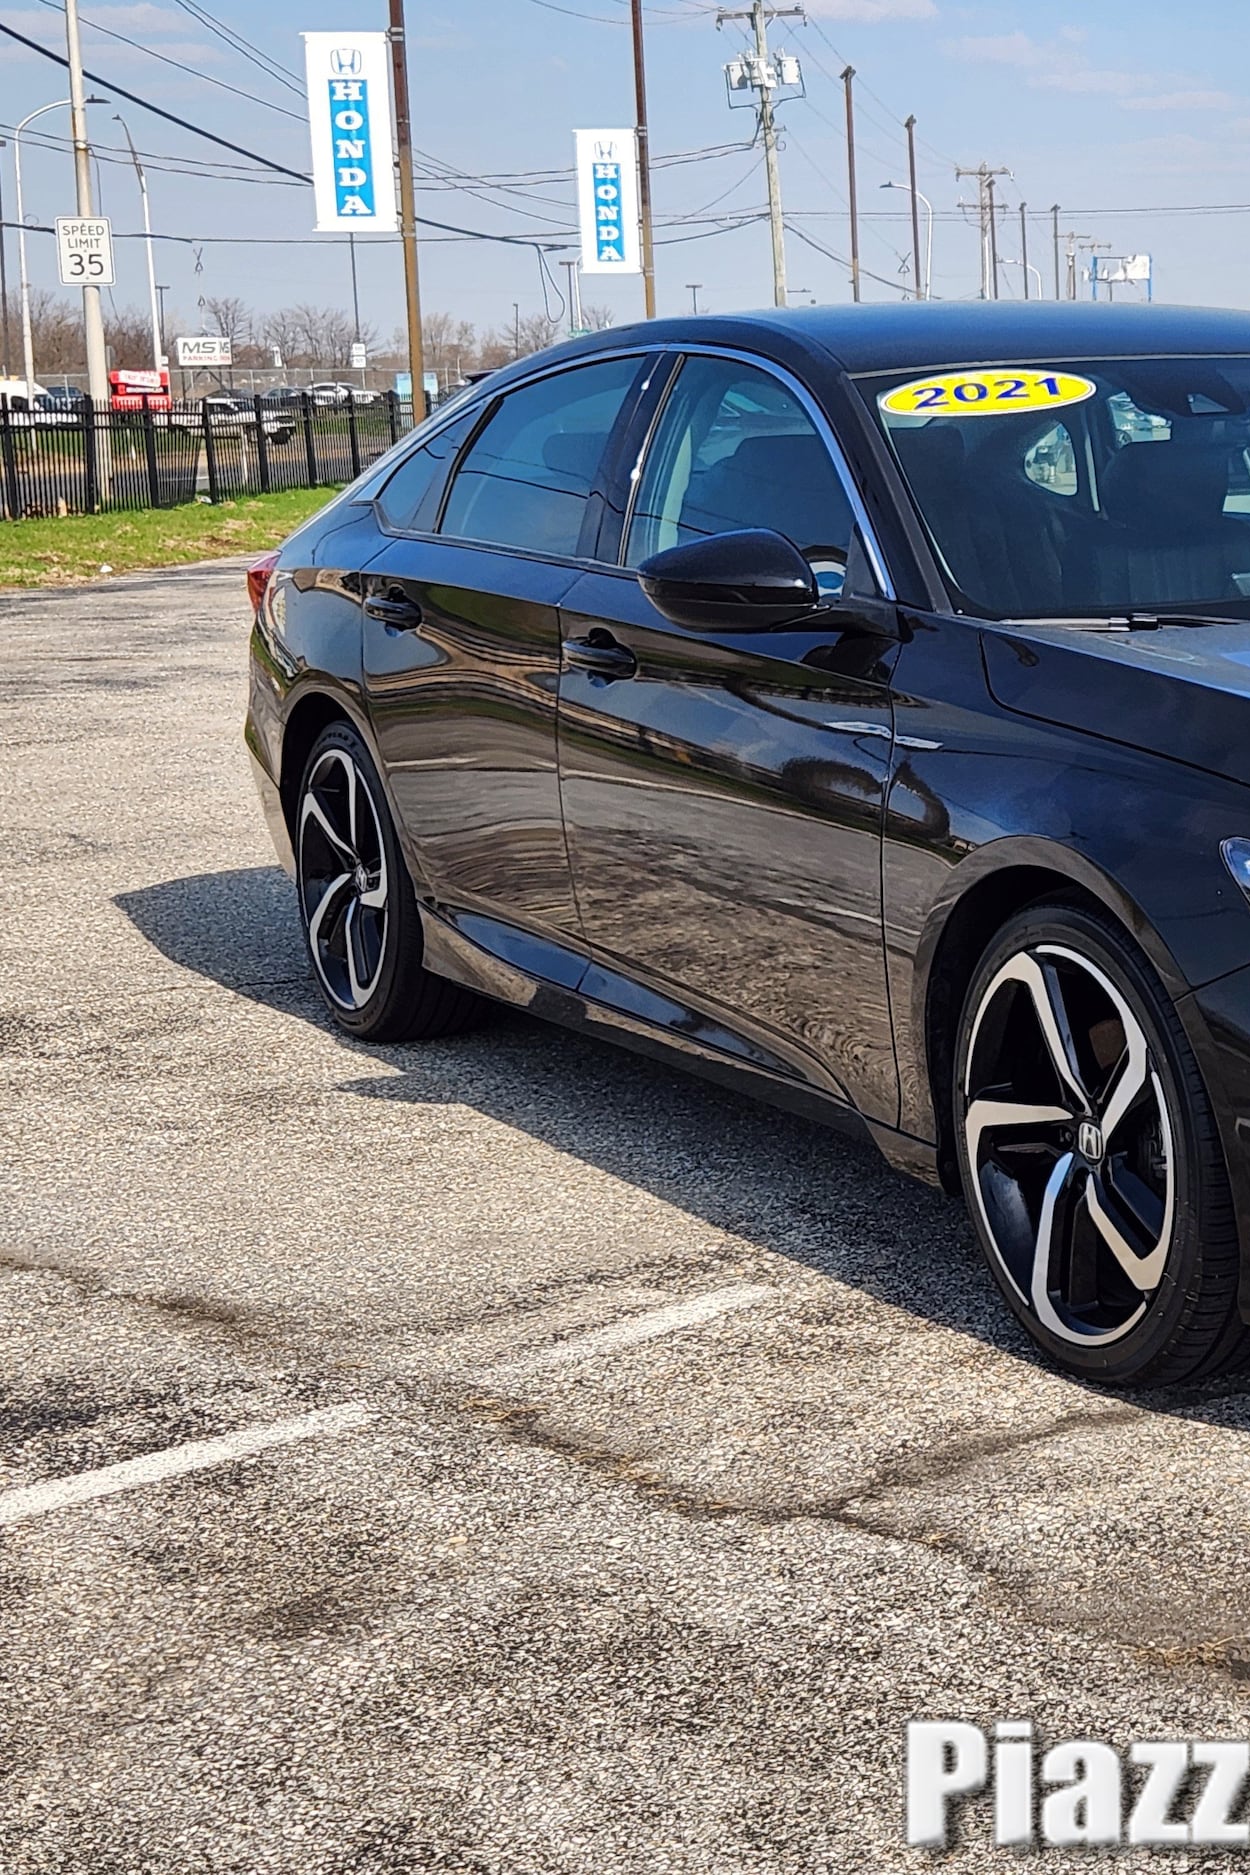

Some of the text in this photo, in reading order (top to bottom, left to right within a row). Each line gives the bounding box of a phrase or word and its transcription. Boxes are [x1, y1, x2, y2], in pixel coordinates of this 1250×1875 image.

[331, 82, 372, 214] HONDA
[595, 165, 622, 260] HONDA
[62, 225, 105, 236] SPEED
[67, 238, 101, 249] LIMIT
[68, 253, 104, 276] 35
[912, 377, 1061, 410] 2021
